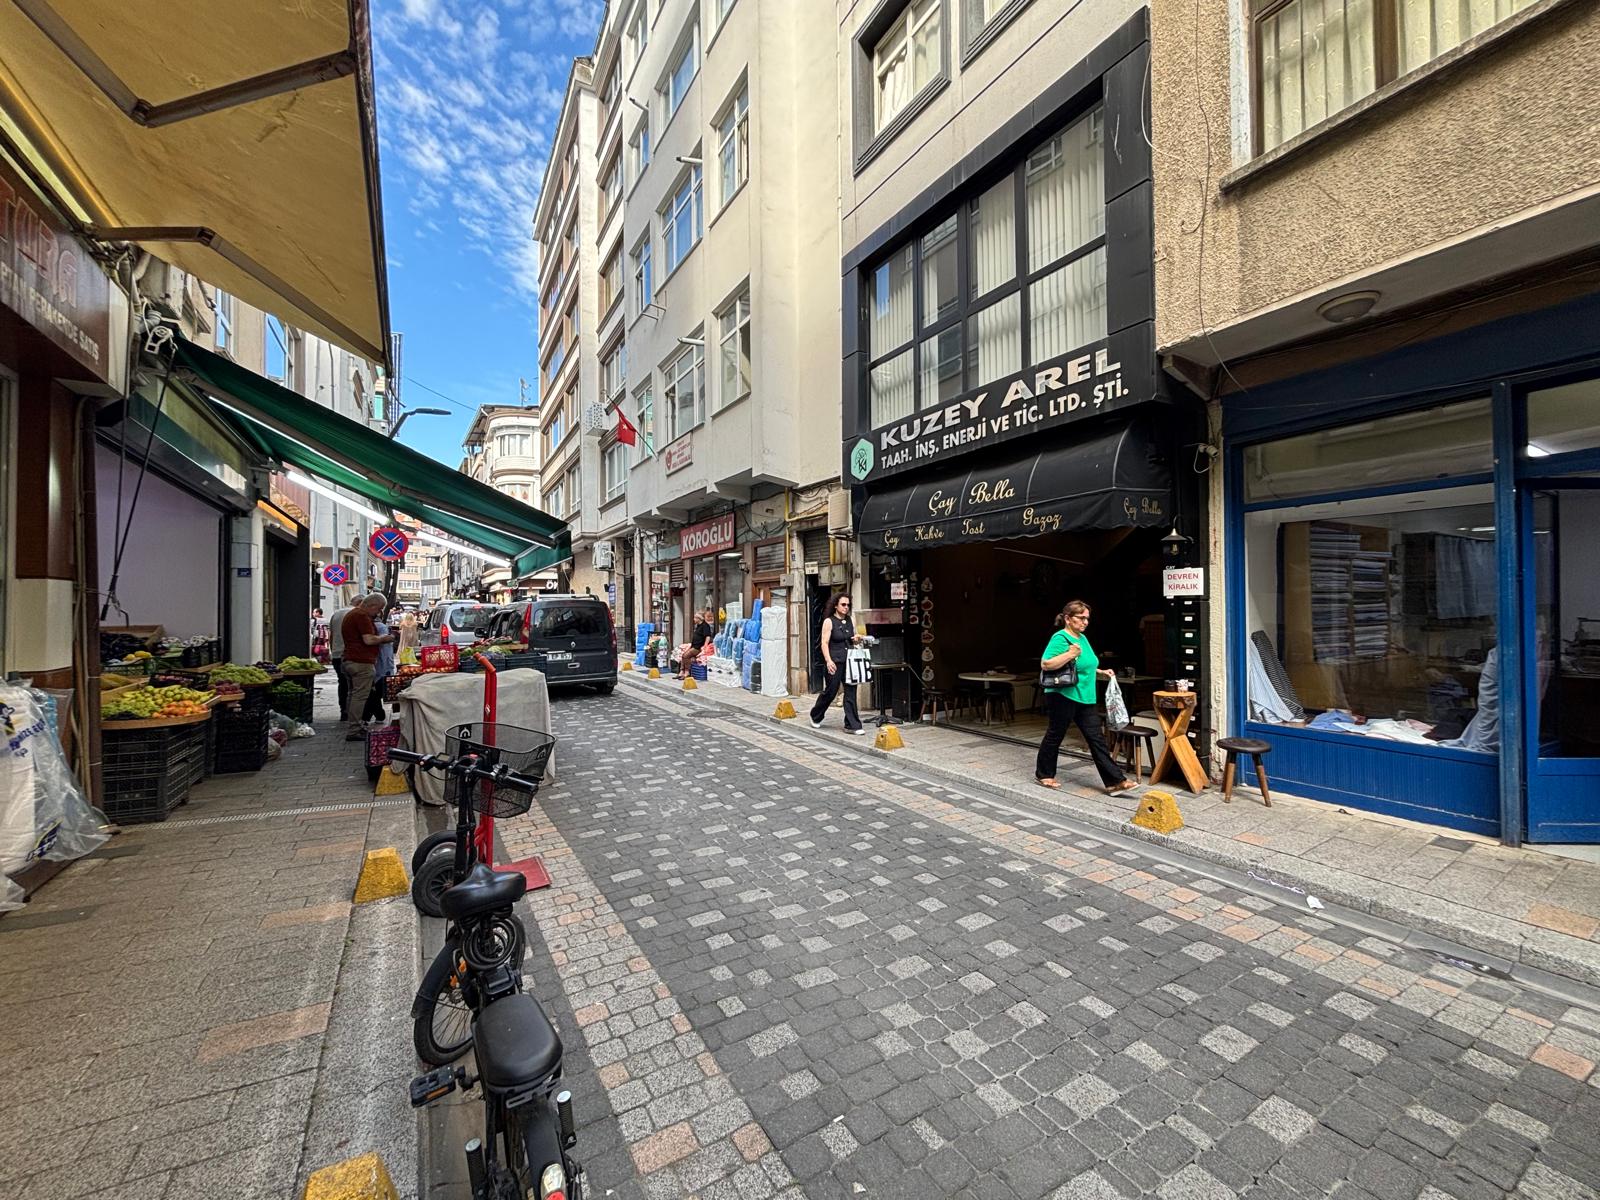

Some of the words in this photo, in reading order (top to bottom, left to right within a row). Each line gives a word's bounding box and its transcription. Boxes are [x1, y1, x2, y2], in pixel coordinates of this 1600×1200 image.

[881, 392, 989, 451] KUZEY
[1001, 348, 1121, 409] AREL
[881, 448, 912, 470] TAAH.
[915, 439, 939, 459] İNŞ.
[943, 417, 987, 450] ENERJİ
[990, 414, 1010, 434] VE
[1013, 403, 1043, 428] TİC.
[1049, 392, 1087, 417] LTD.
[1093, 372, 1129, 409] ŞTİ.
[928, 490, 957, 517] Çay
[968, 478, 1016, 505] Bella
[1123, 497, 1137, 521] Çay
[1141, 496, 1162, 515] Bella
[884, 529, 900, 549] Çay
[914, 525, 945, 542] Kahve
[961, 518, 986, 536] Tost
[1022, 507, 1063, 532] Gazoz
[1167, 572, 1199, 580] DEVREN
[1168, 582, 1199, 590] KİRALIK
[848, 657, 873, 684] LTB
